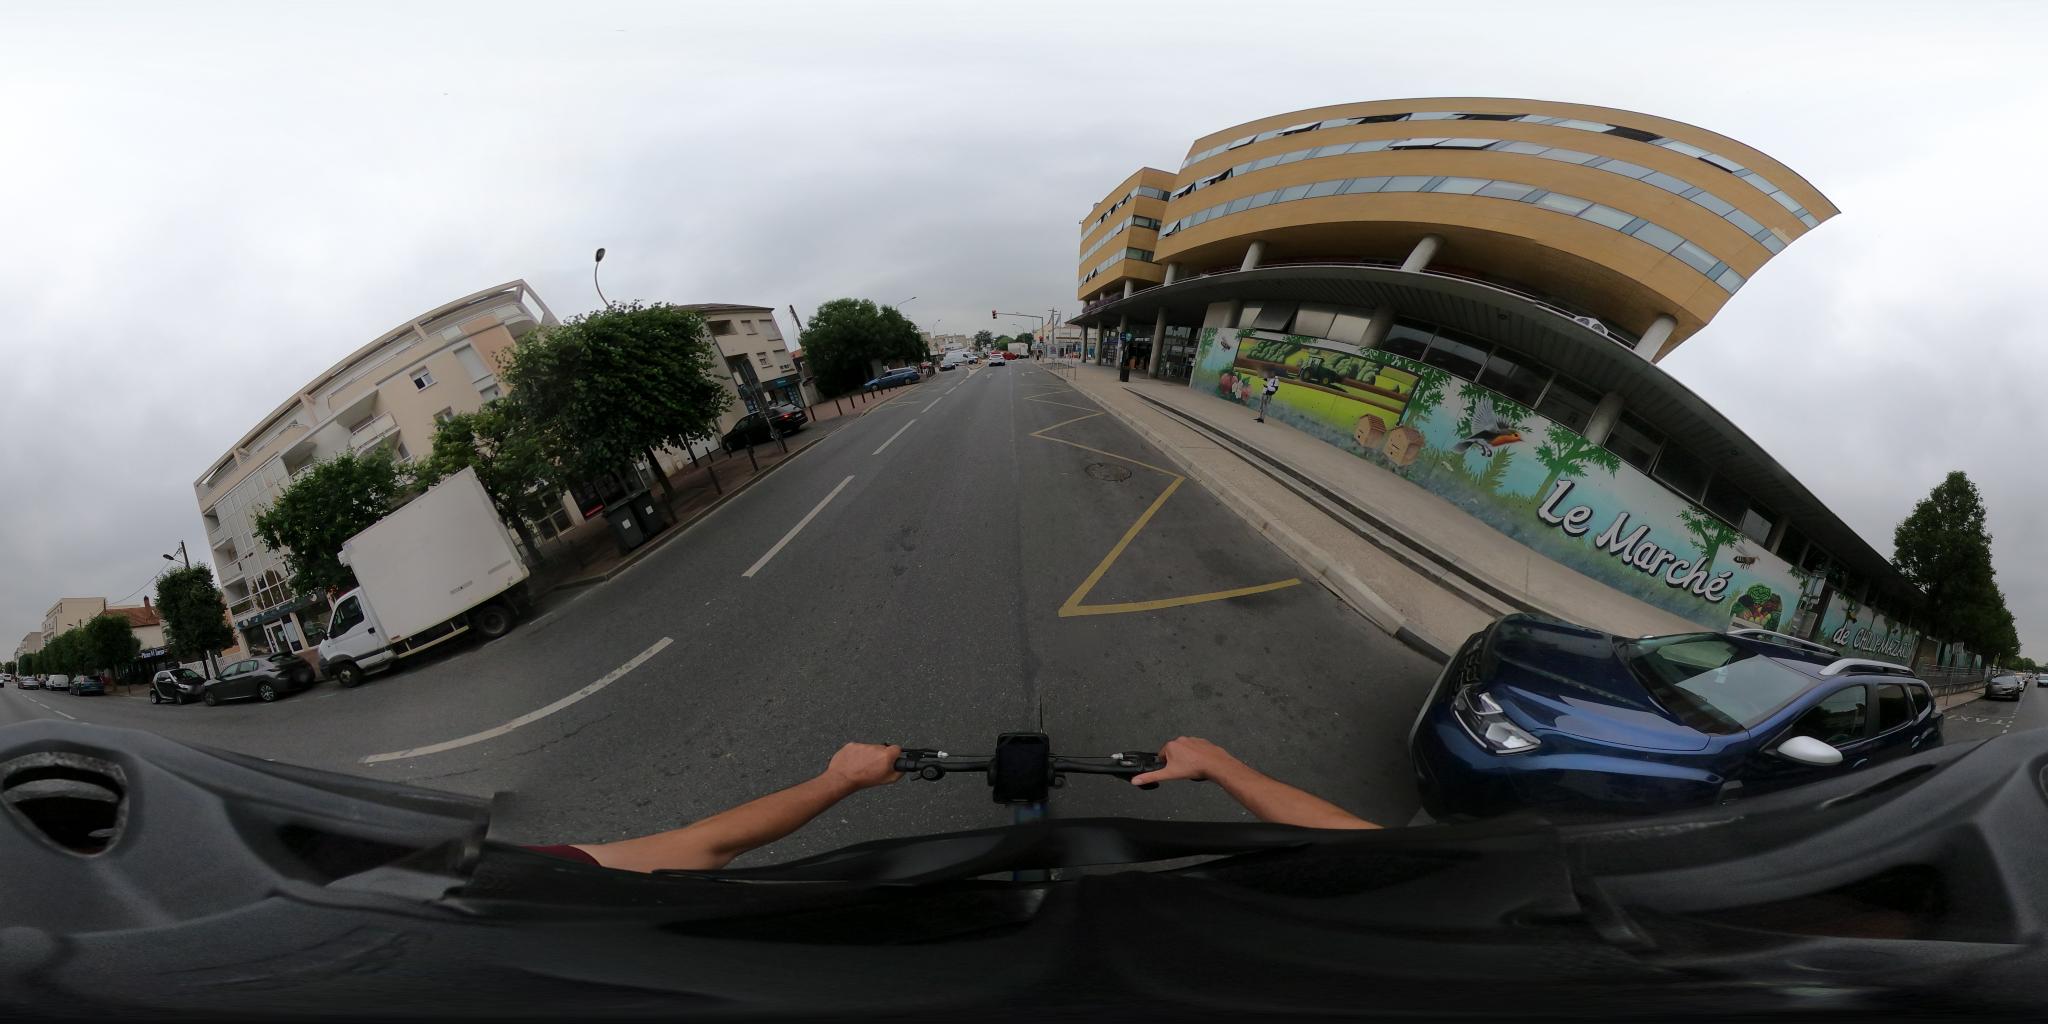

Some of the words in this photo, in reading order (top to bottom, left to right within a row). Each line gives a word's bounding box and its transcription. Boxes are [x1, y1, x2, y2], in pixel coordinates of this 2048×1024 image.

[1537, 479, 1593, 536] Le
[1595, 511, 1734, 604] Marché
[1833, 623, 1851, 646] de
